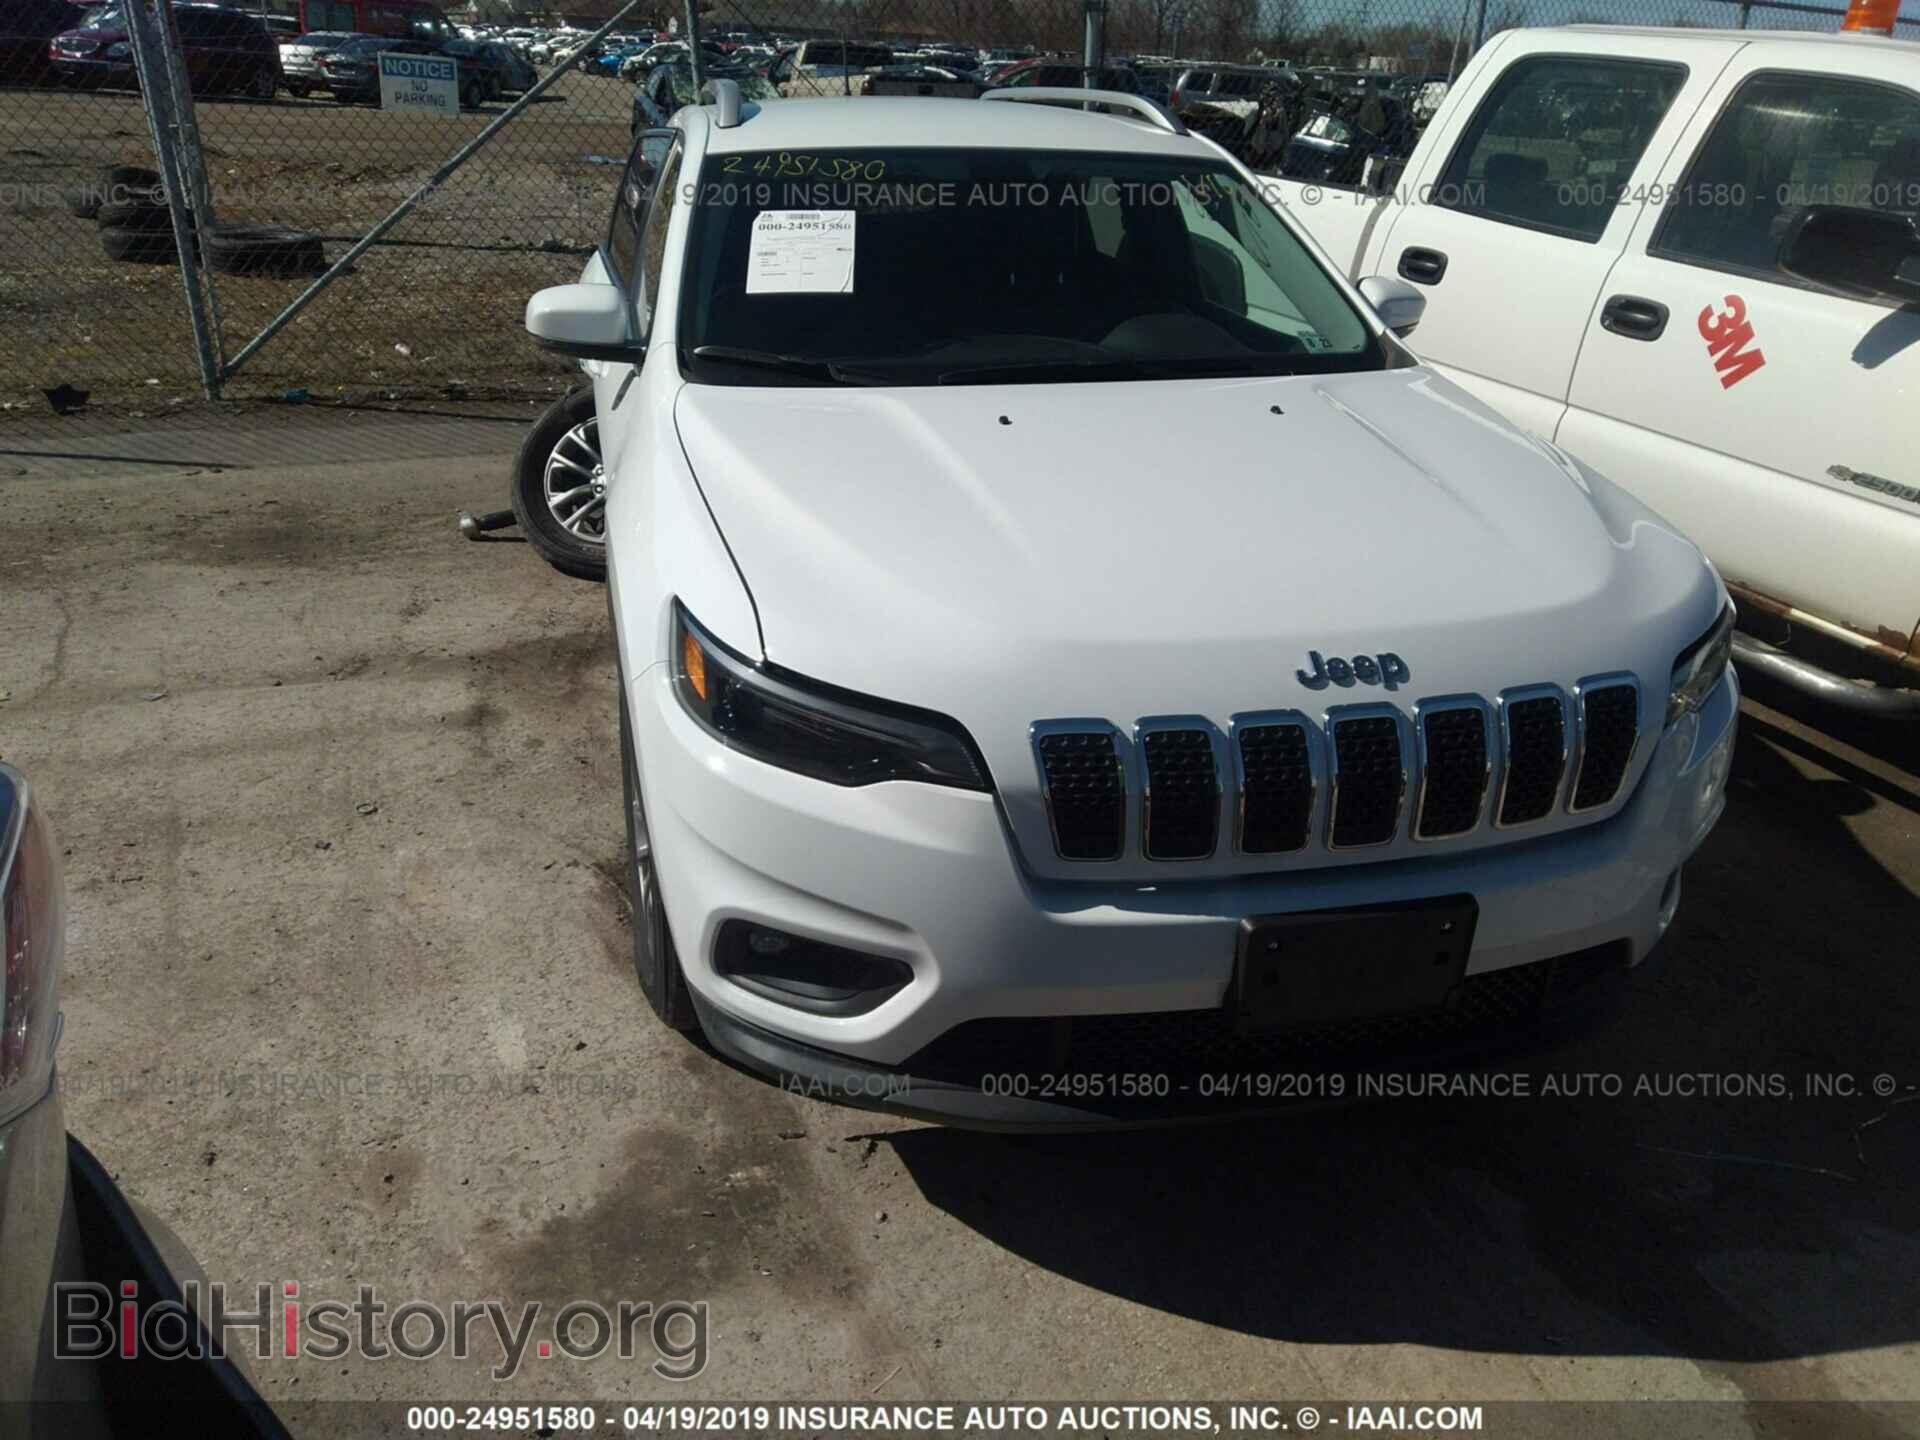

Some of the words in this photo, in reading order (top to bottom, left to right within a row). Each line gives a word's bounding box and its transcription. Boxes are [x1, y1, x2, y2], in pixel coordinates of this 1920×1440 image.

[384, 58, 452, 78] NOTICE
[411, 79, 428, 93] NO
[394, 91, 447, 108] PARKING
[1697, 293, 1767, 391] 3M
[1295, 649, 1411, 692] Jeep
